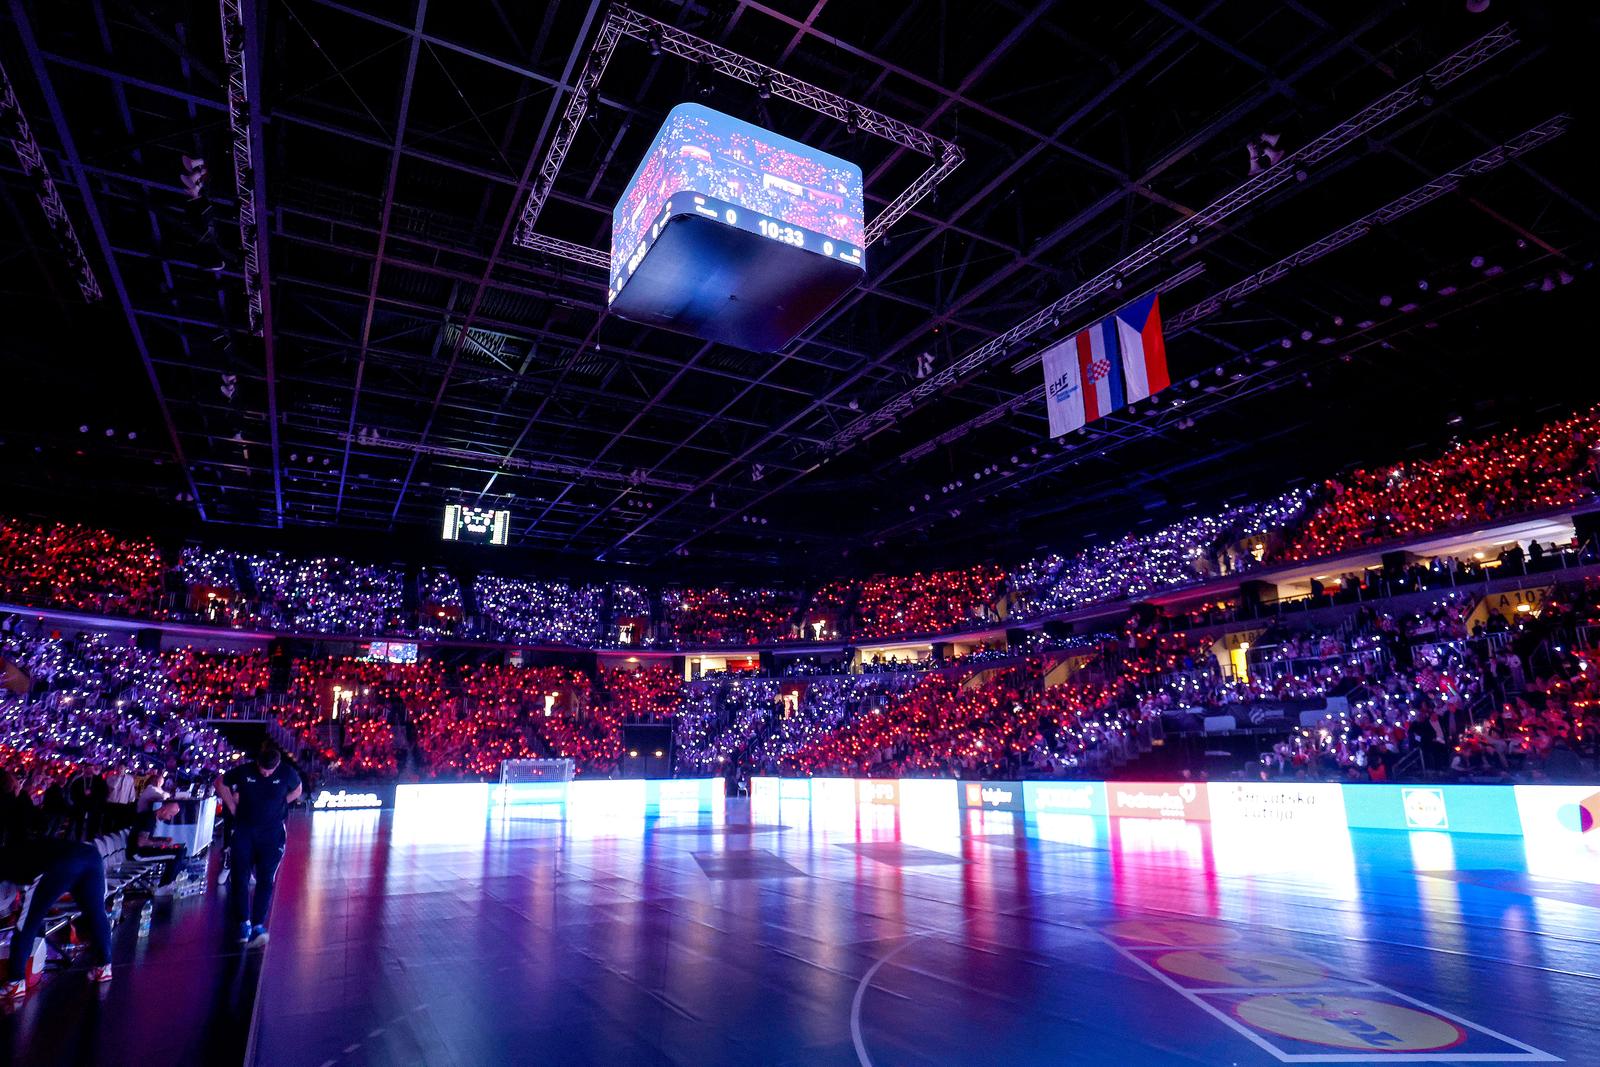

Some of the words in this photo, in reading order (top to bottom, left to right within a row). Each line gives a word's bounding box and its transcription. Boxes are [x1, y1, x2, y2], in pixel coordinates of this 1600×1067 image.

[726, 209, 737, 225] 0
[758, 219, 804, 248] 10:33
[1049, 372, 1069, 395] EHF
